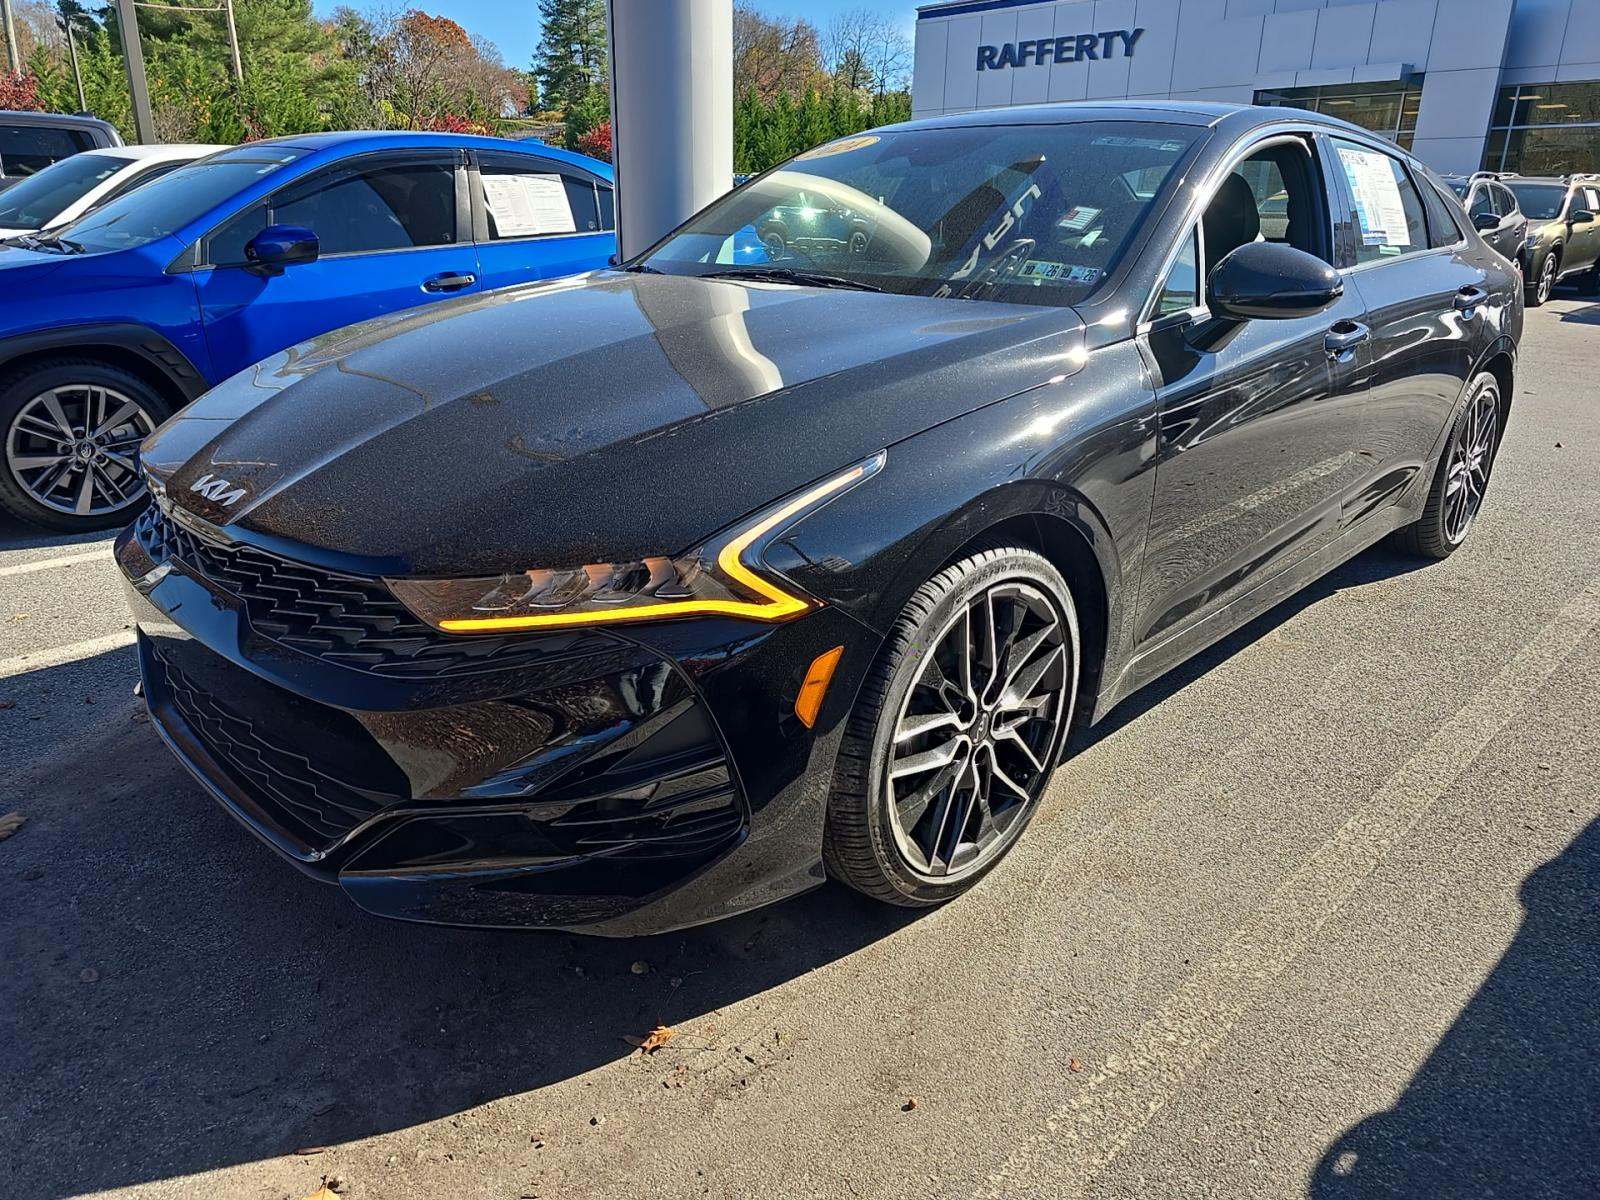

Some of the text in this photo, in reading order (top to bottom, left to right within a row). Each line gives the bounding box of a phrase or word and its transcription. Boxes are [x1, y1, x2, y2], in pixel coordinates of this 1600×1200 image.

[976, 28, 1145, 71] RAFFERTY
[1046, 265, 1059, 278] 26
[1083, 269, 1097, 282] 26
[190, 474, 247, 507] KIA
